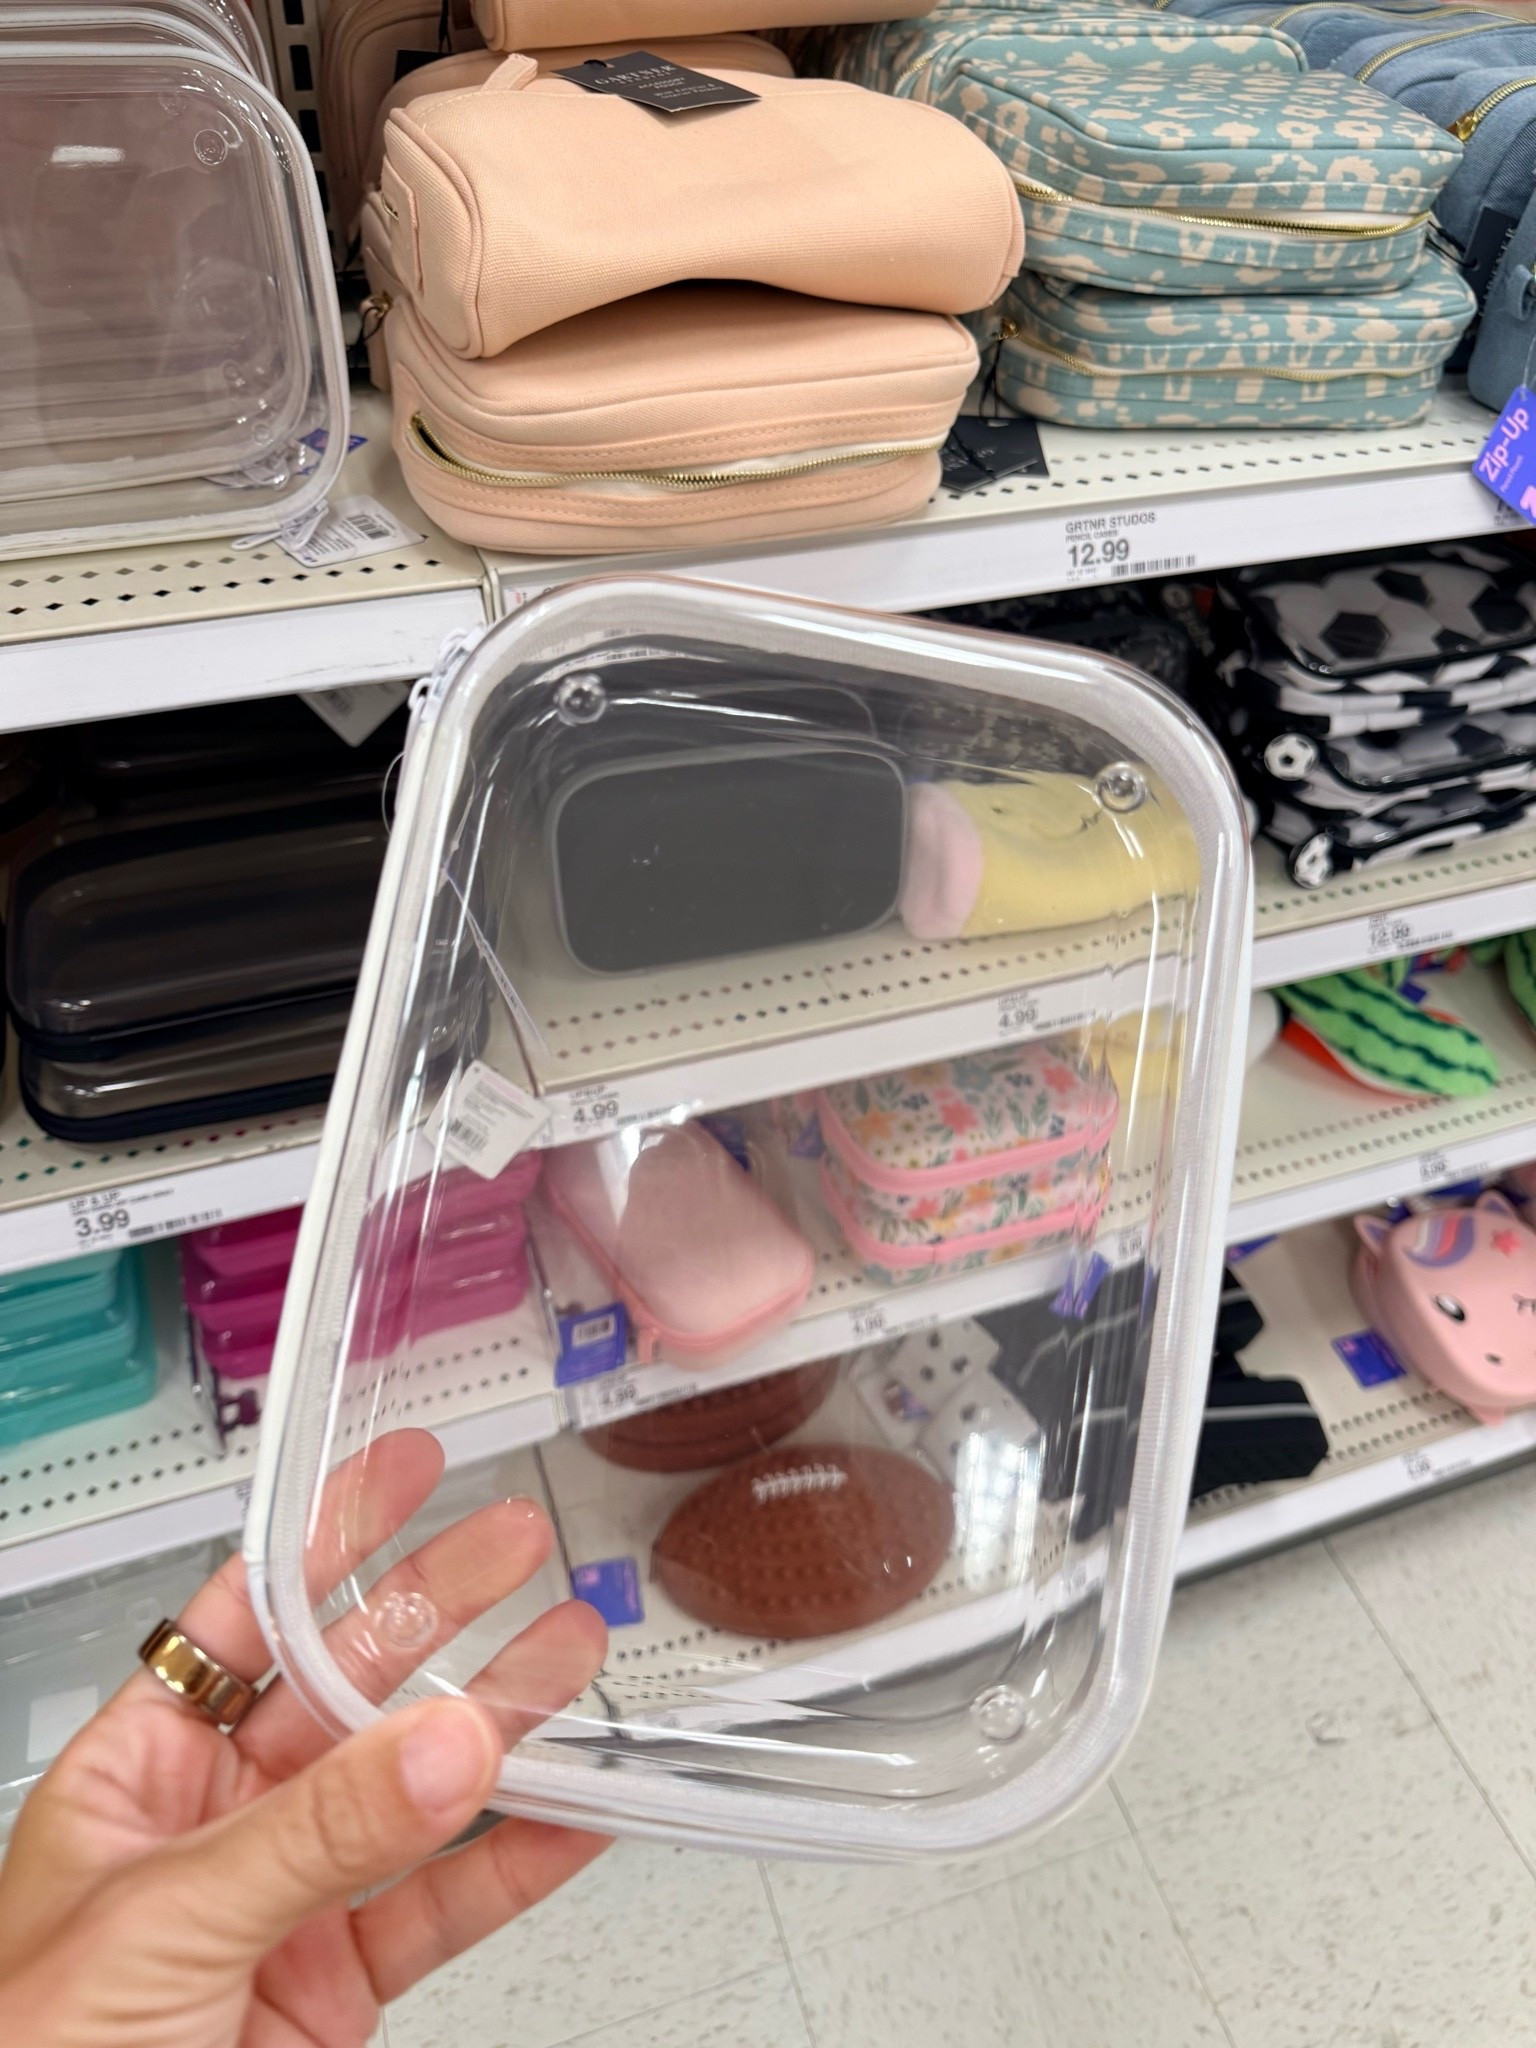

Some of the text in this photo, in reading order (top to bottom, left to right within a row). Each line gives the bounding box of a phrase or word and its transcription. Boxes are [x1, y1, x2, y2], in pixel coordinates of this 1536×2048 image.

[1479, 408, 1529, 482] Zip-Up
[1065, 519, 1106, 534] GRTNR
[1067, 538, 1129, 568] 12.99
[573, 1099, 619, 1122] 4.99
[75, 1208, 130, 1237] 3.99
